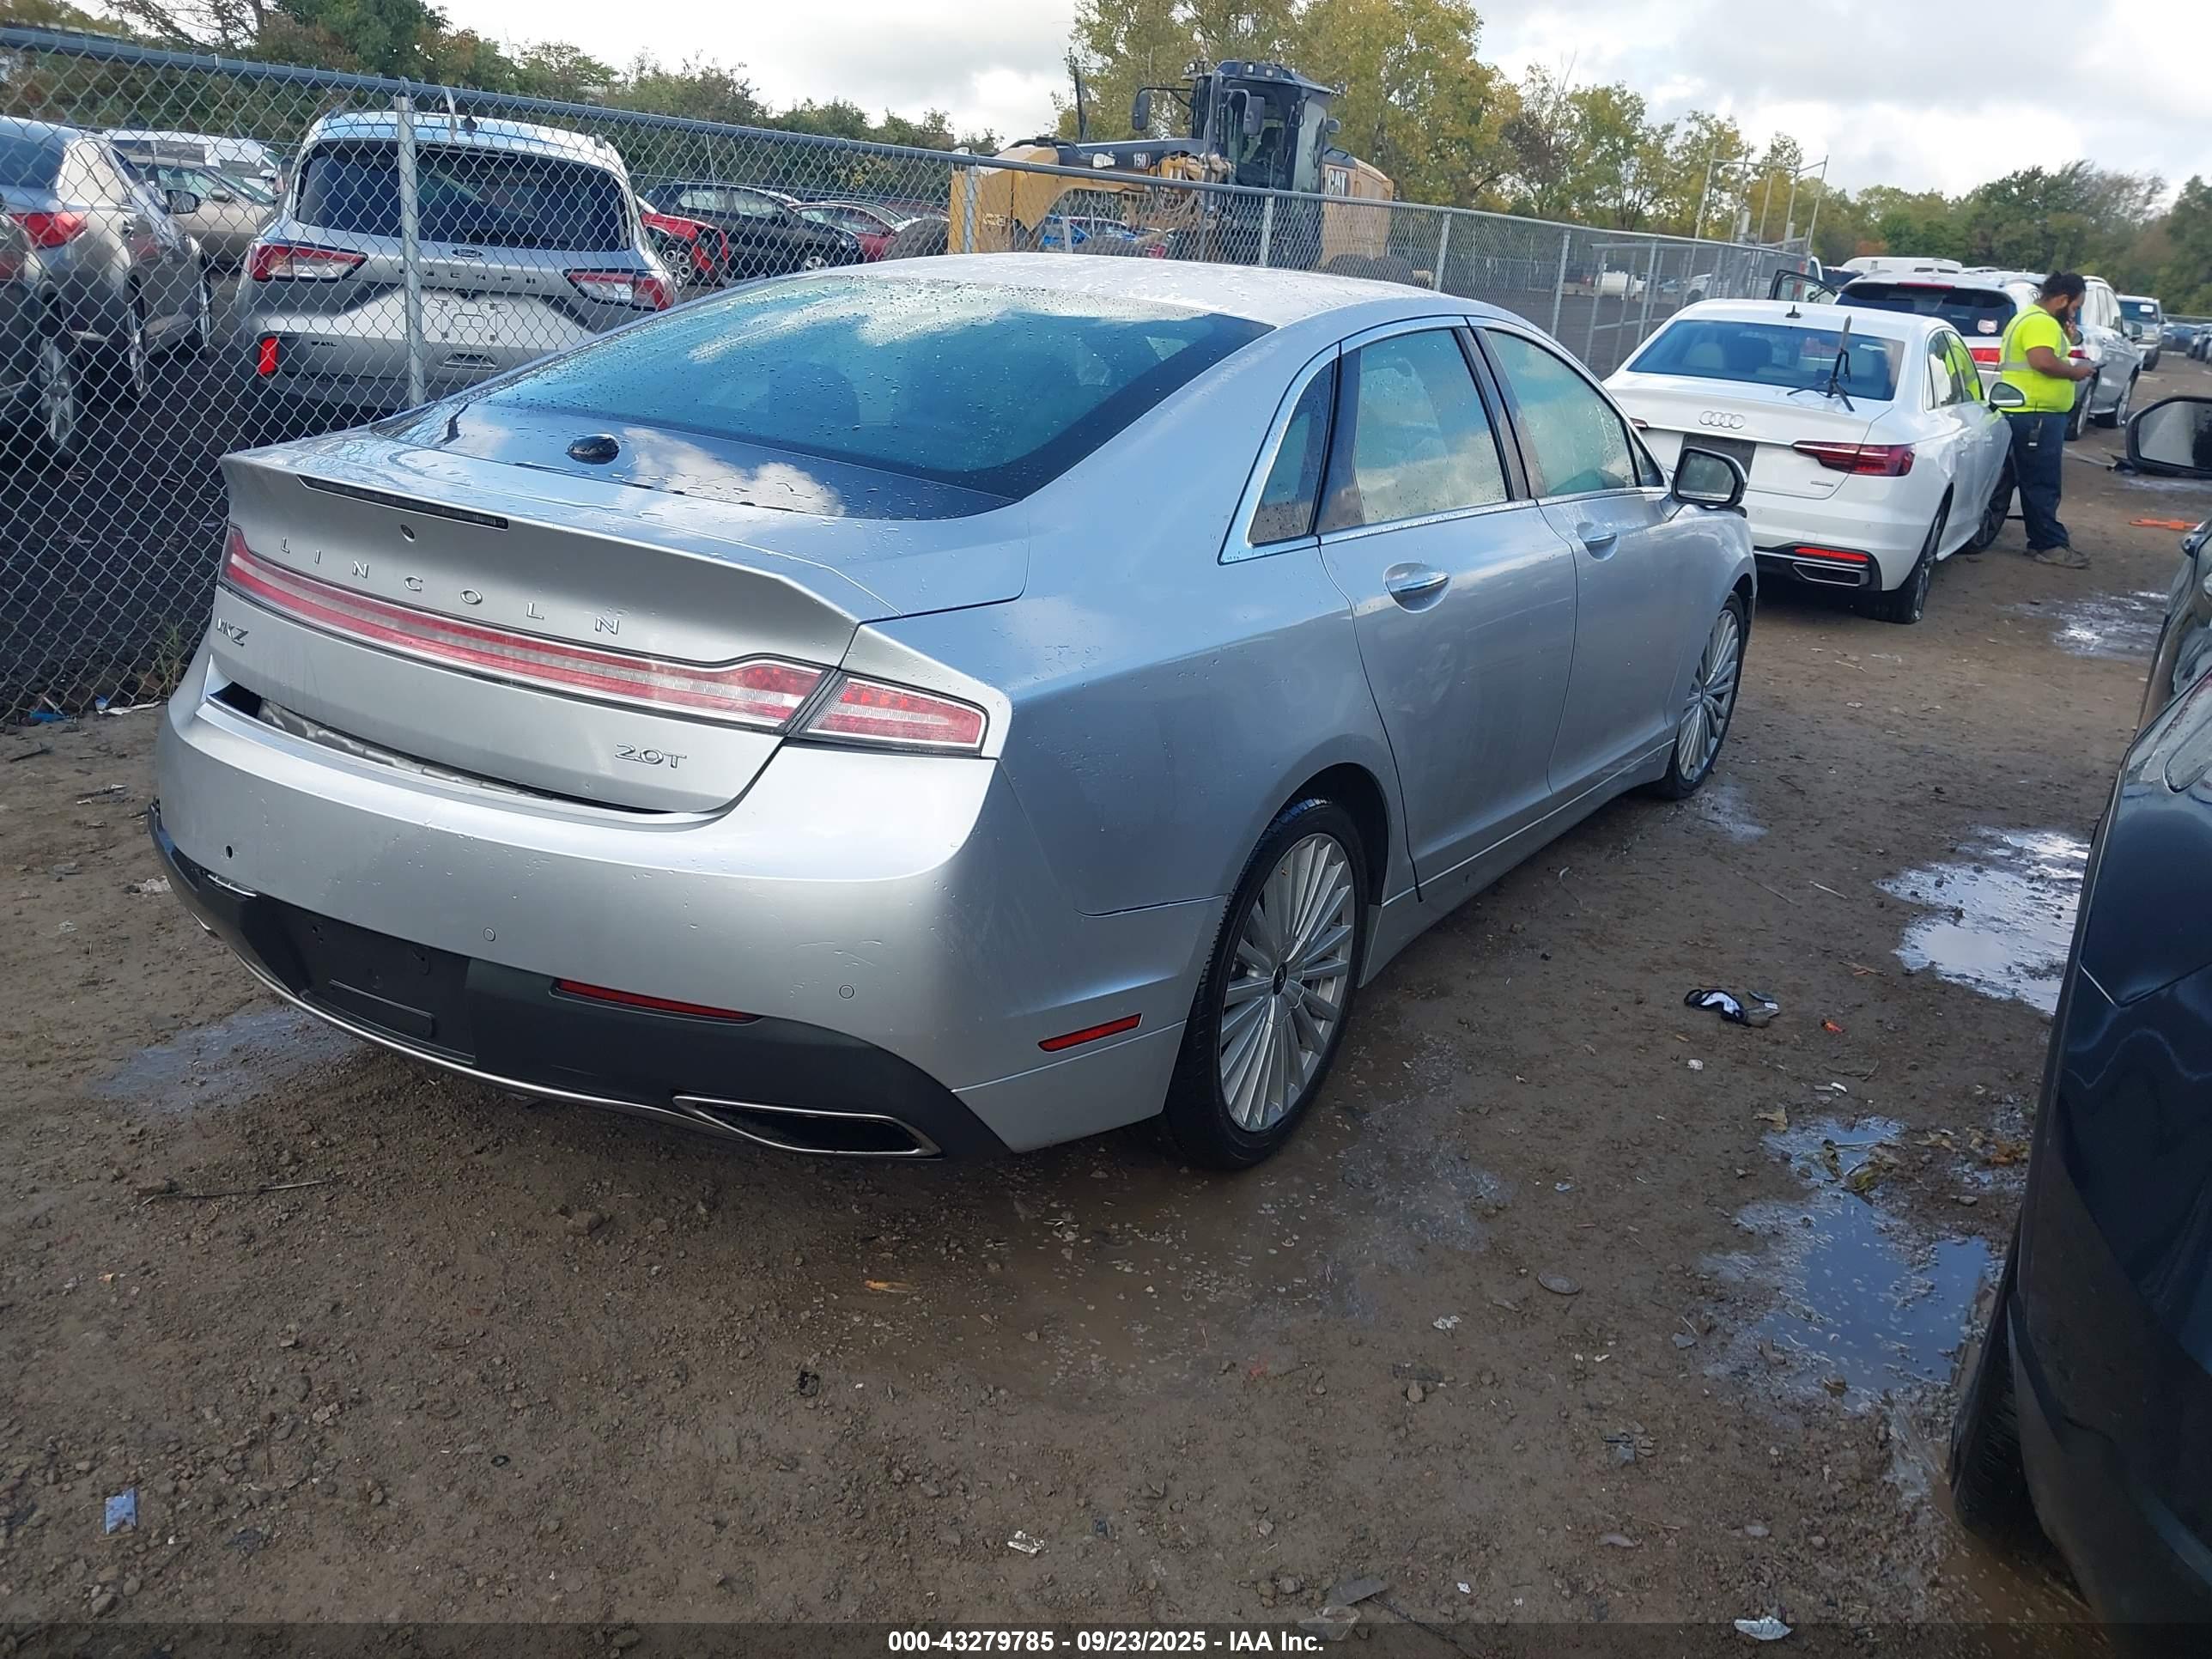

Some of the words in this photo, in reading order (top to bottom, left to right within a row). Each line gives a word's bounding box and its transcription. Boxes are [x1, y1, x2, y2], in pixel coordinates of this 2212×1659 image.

[1133, 152, 1146, 167] 150
[1328, 169, 1346, 197] CAT
[280, 537, 620, 635] LINCOLN
